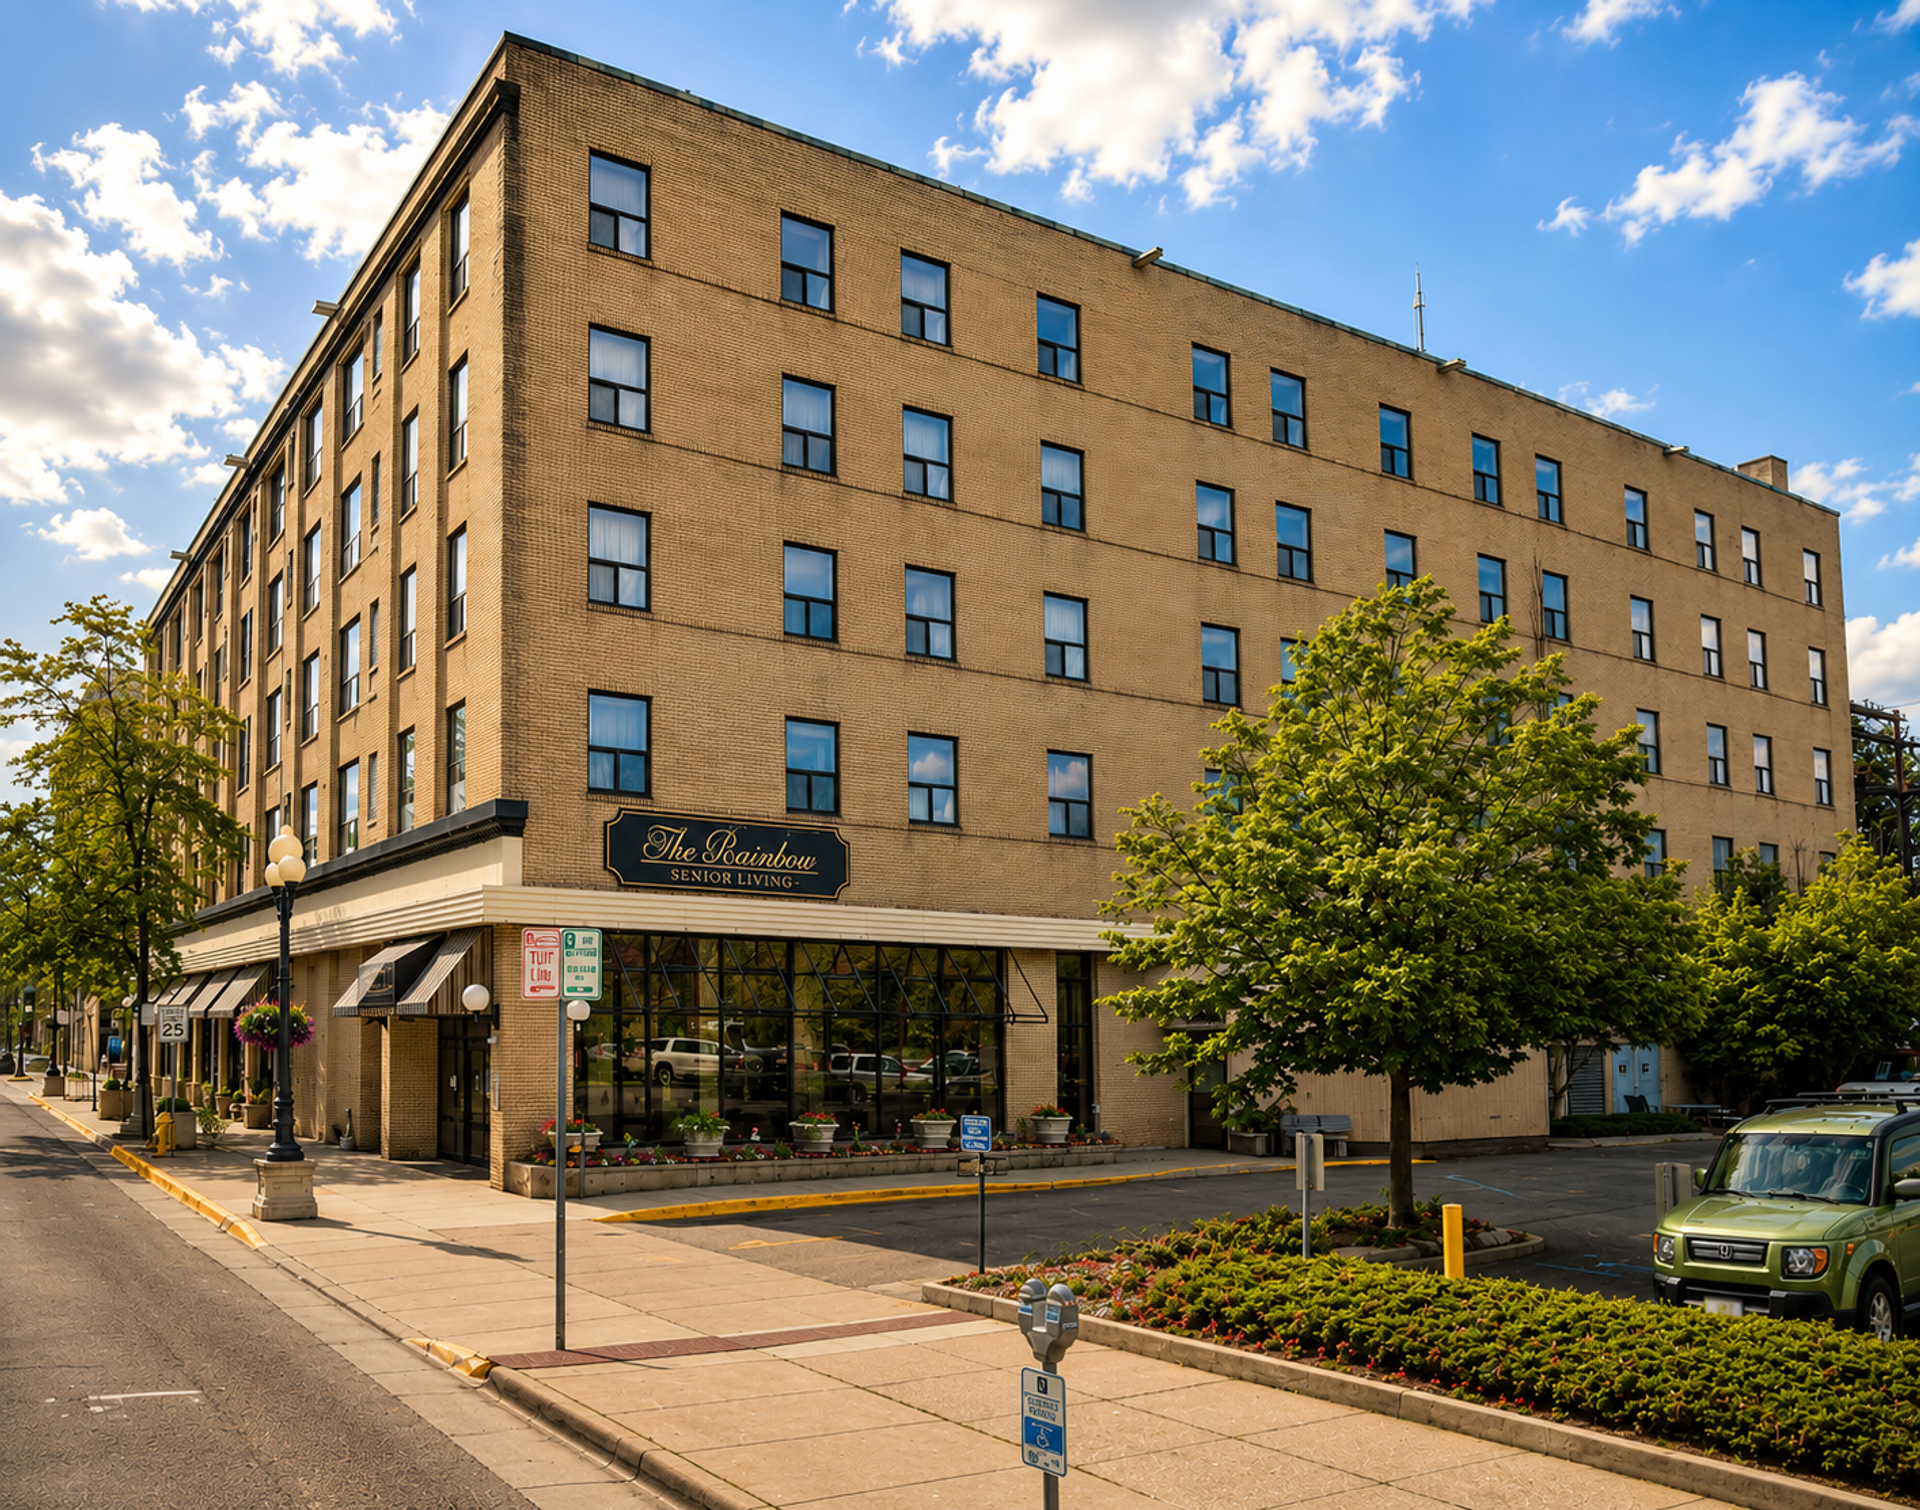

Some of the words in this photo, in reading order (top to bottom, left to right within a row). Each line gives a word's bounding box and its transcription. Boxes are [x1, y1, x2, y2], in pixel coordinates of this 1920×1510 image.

[643, 824, 698, 862] The
[702, 825, 819, 870] Rainbow
[670, 868, 732, 885] SENIOR
[162, 1022, 184, 1037] 25
